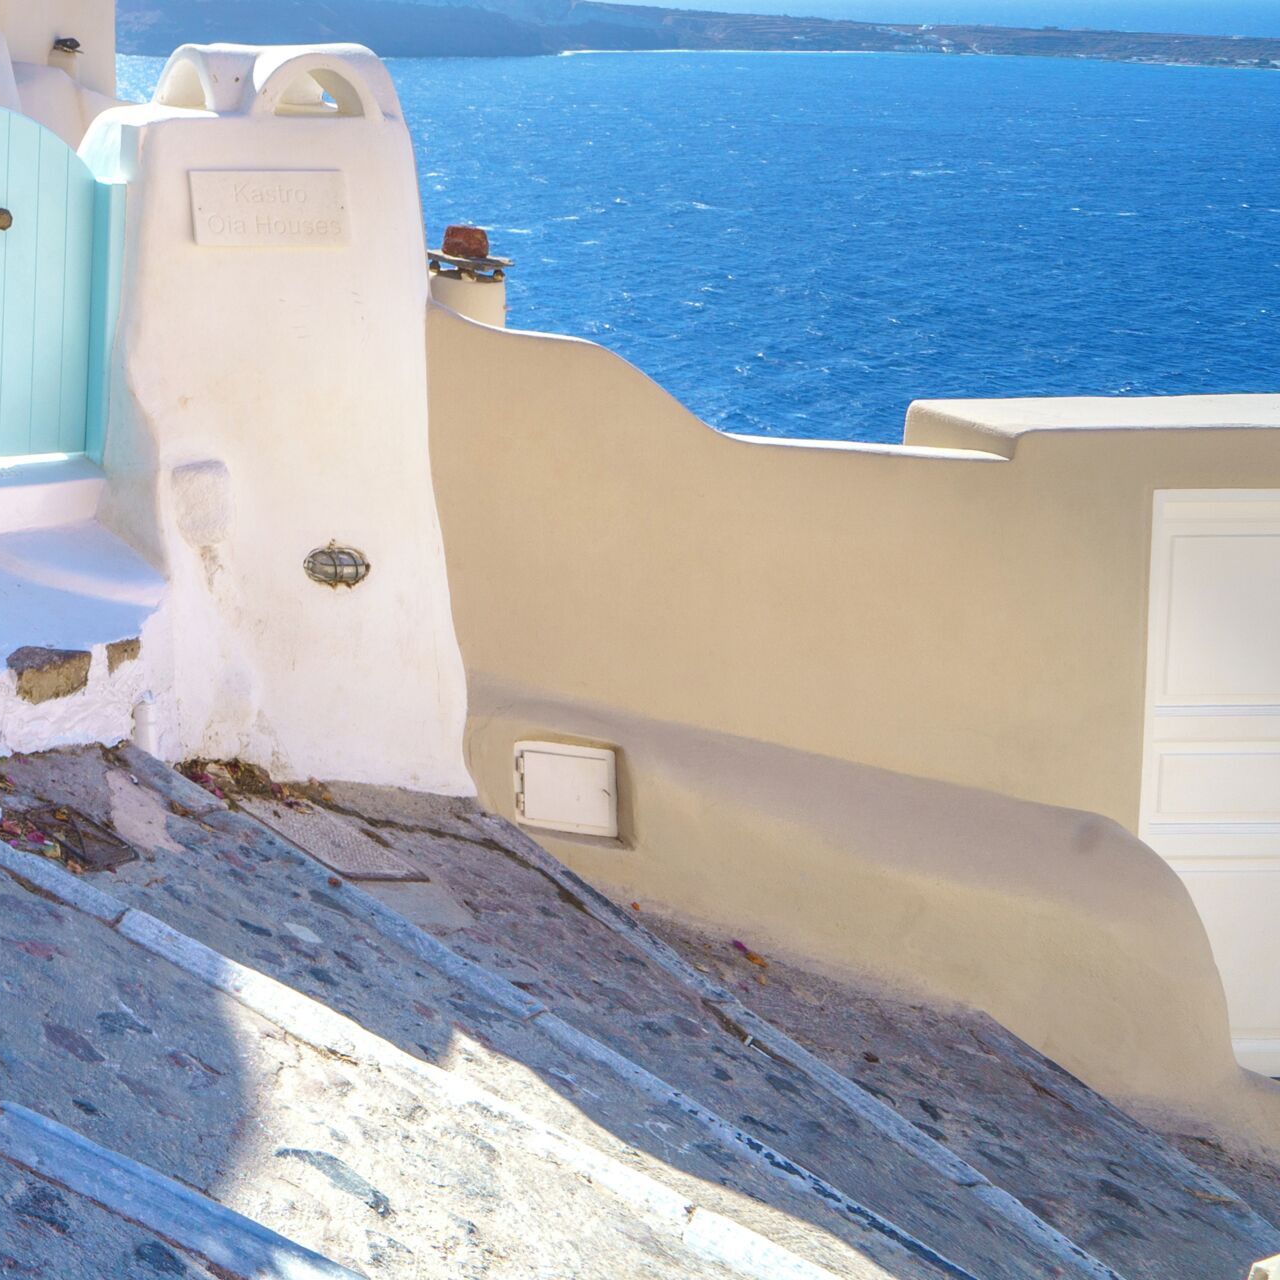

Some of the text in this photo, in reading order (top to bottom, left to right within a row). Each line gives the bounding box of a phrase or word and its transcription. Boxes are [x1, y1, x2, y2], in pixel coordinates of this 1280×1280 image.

[233, 183, 308, 204] Kastro
[208, 214, 342, 235] Oia Houses
